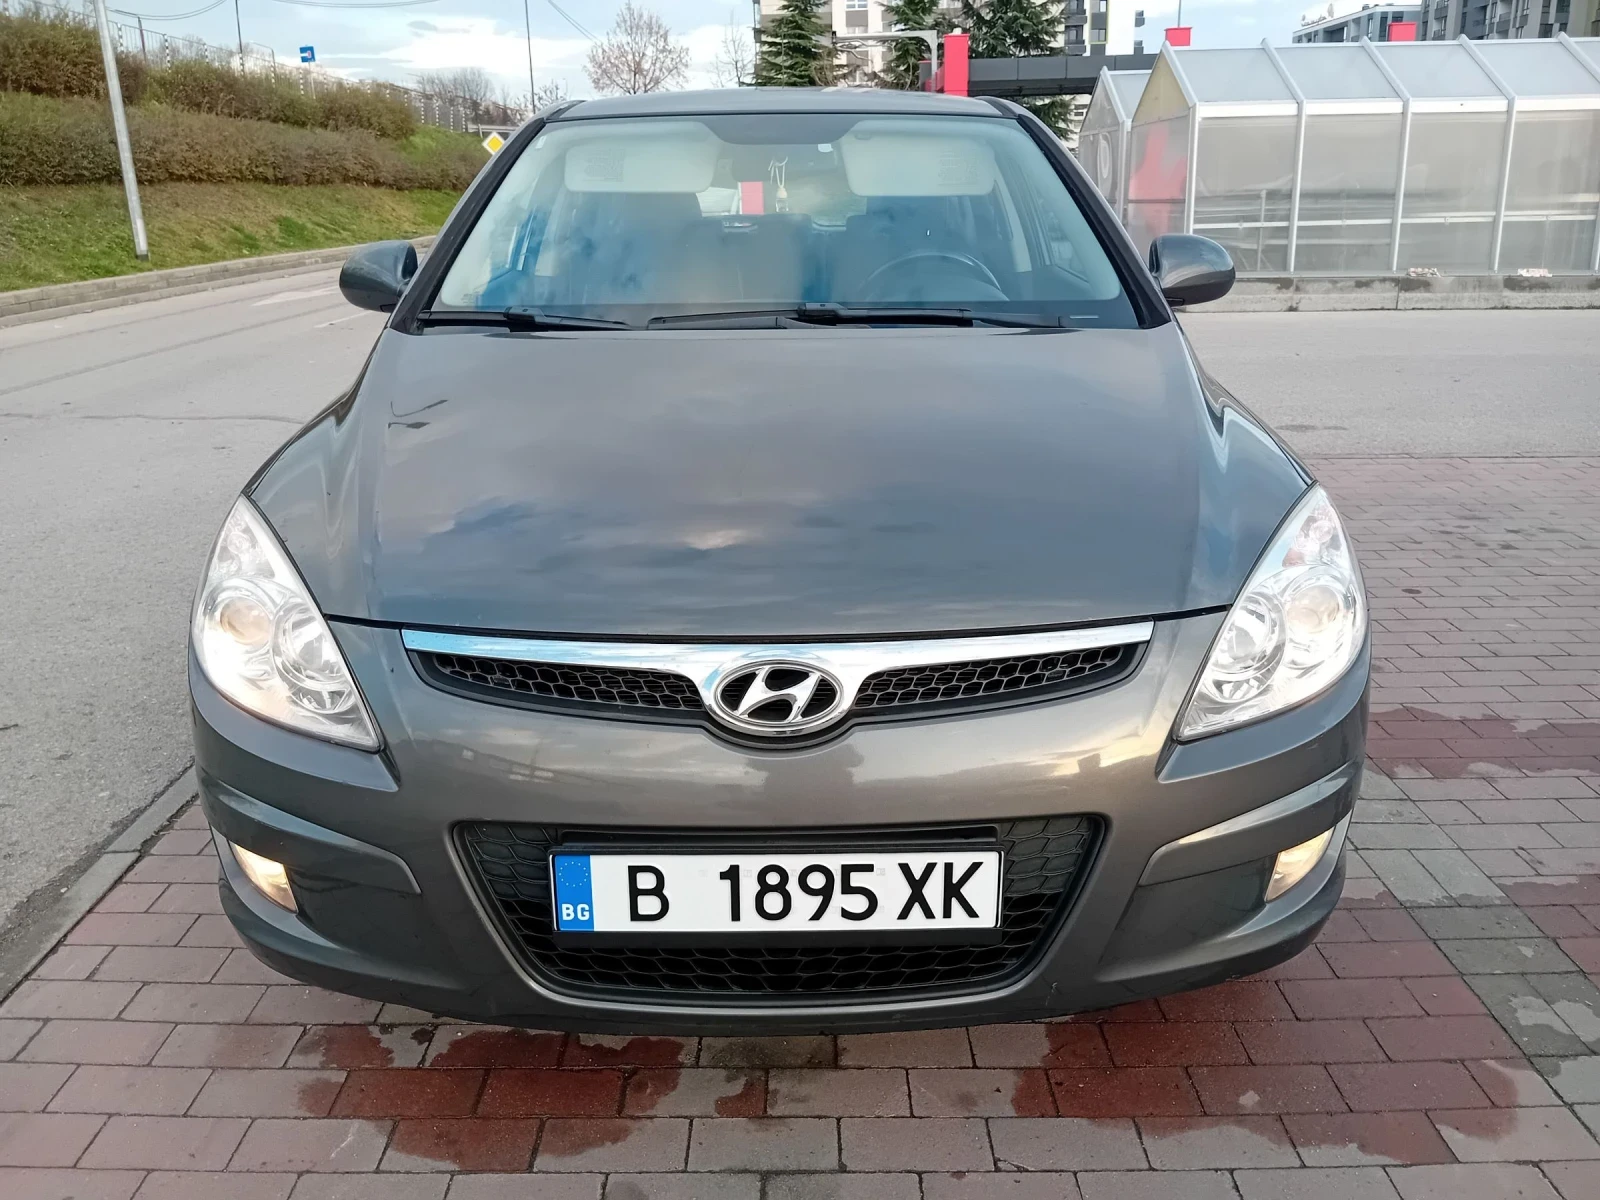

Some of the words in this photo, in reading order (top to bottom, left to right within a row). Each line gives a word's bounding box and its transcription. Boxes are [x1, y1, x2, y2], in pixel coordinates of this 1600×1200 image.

[627, 865, 670, 922] B
[718, 863, 879, 922] 1895
[896, 861, 984, 921] XK
[561, 903, 590, 921] BG
